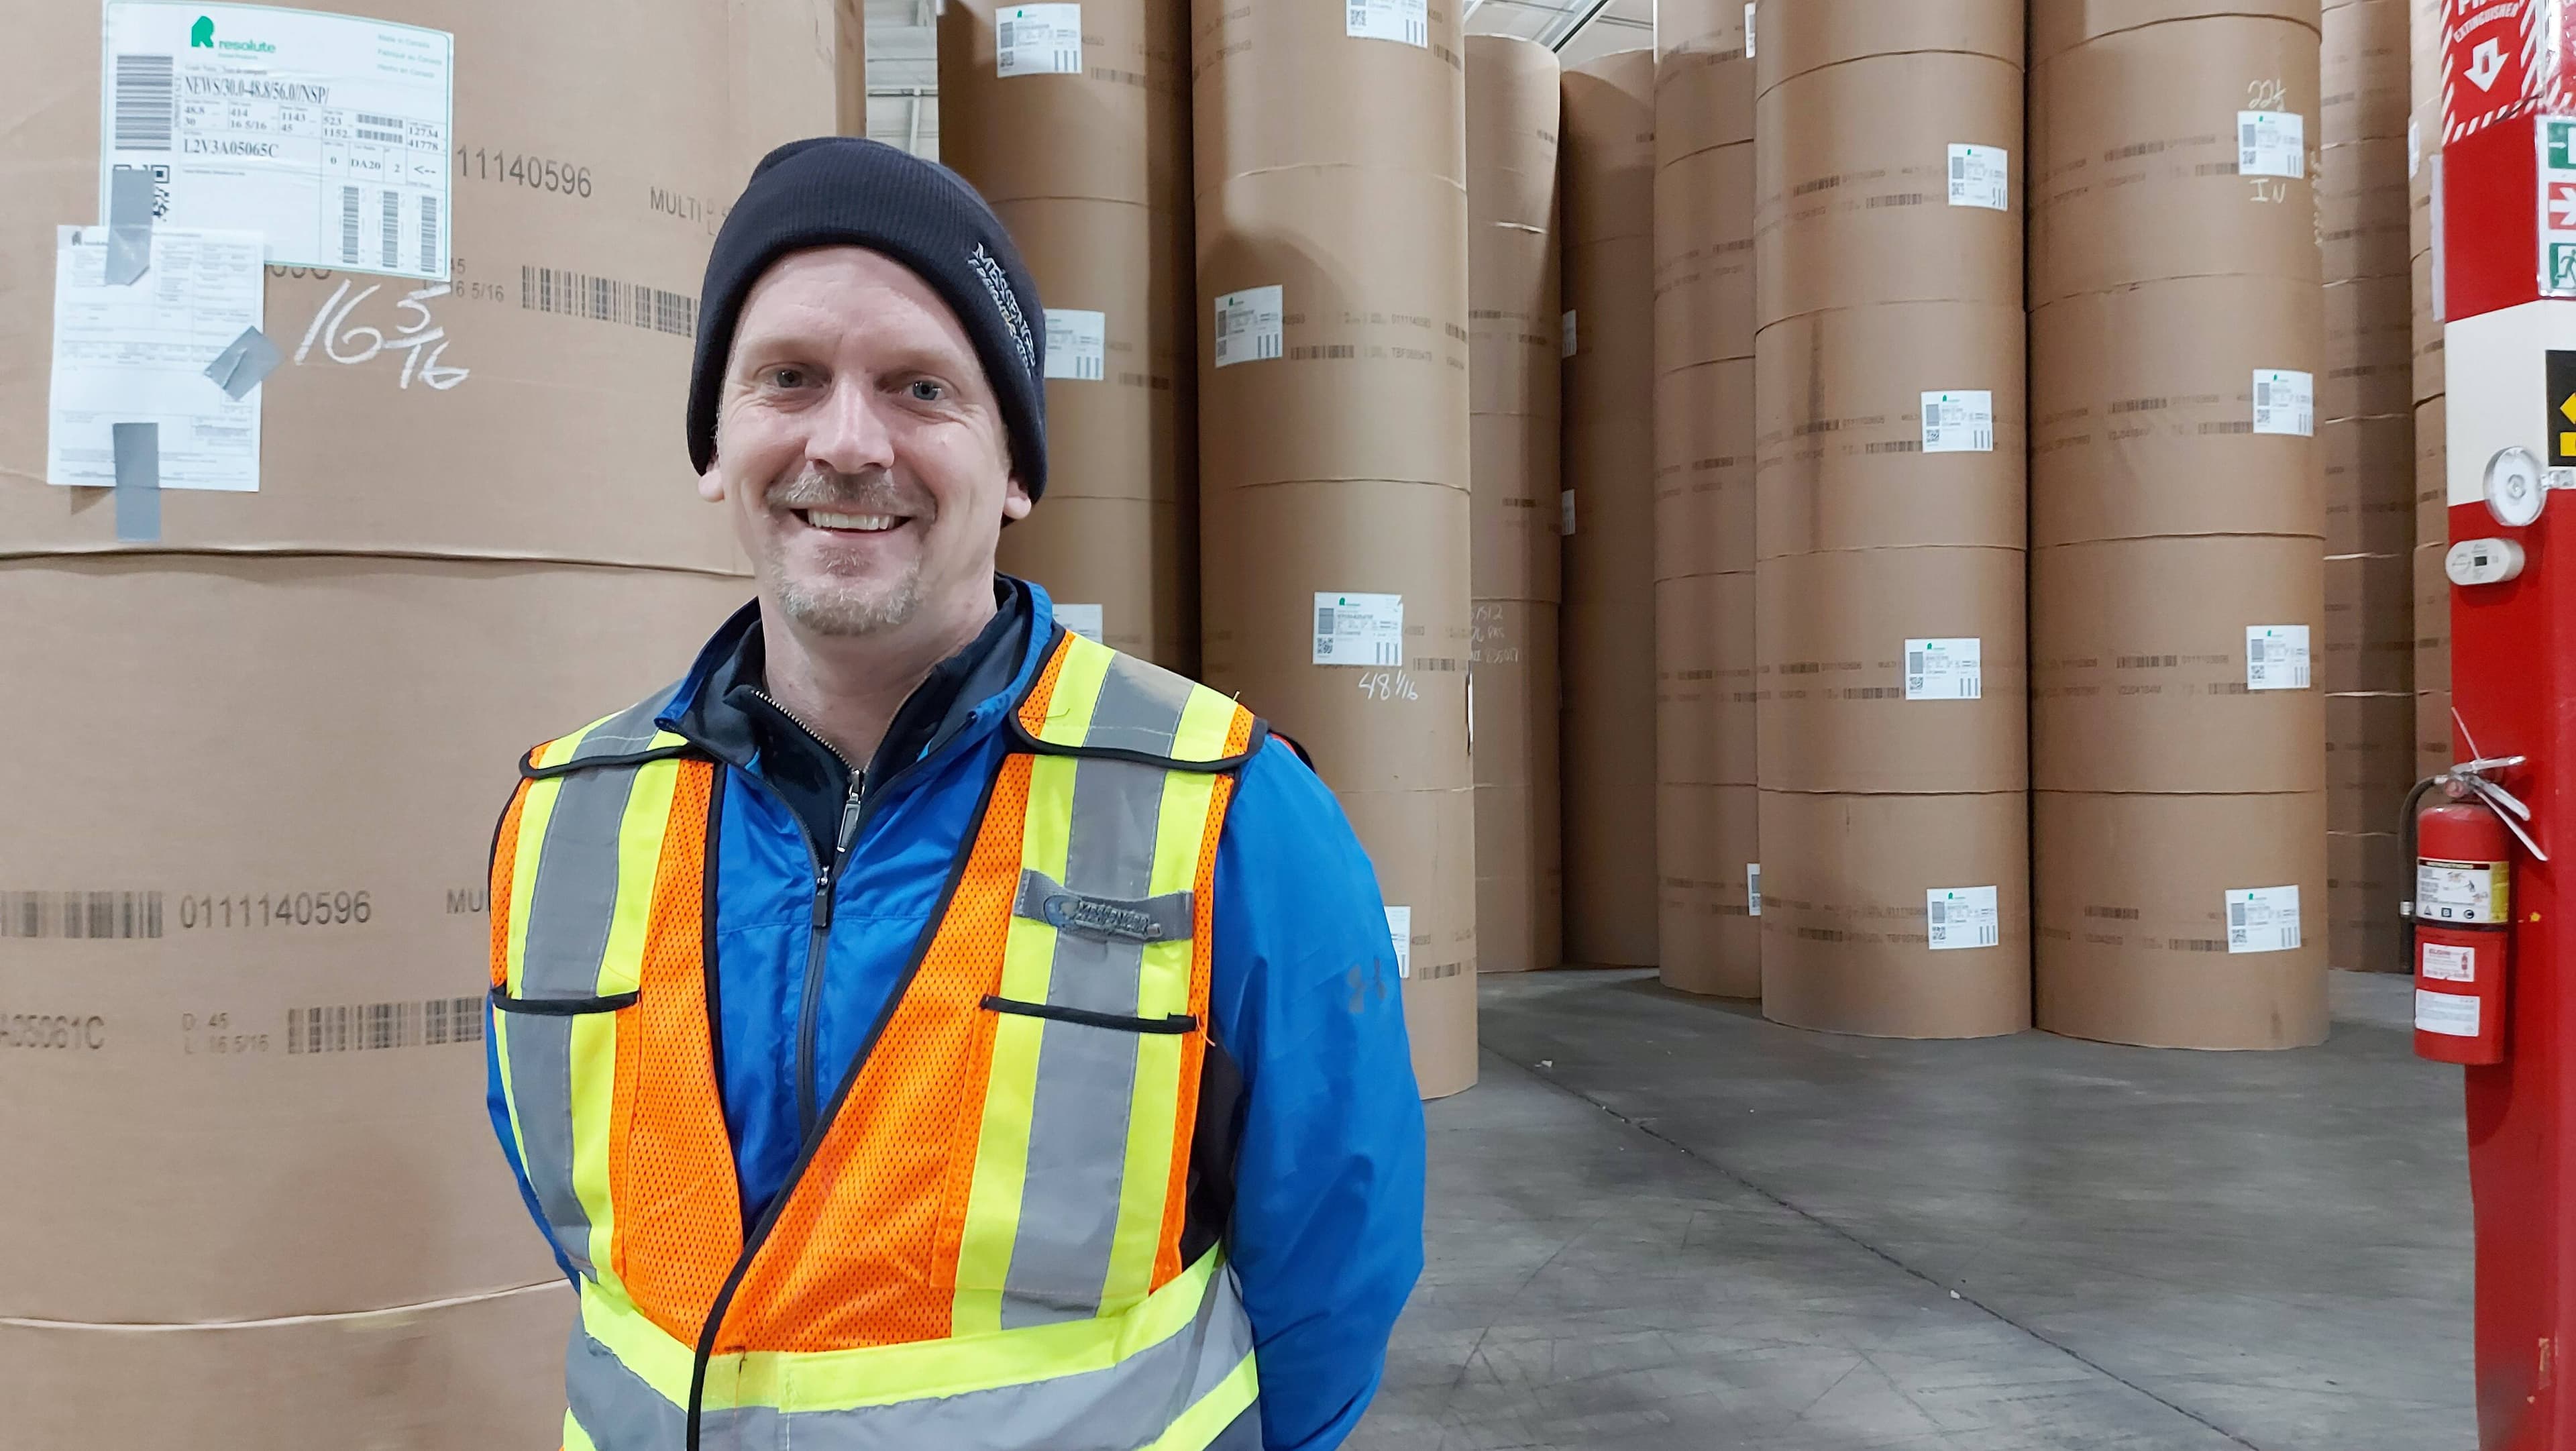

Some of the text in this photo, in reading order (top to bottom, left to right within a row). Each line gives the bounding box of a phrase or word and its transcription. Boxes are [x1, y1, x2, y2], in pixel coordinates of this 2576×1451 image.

[219, 40, 276, 54] resolute
[230, 107, 249, 117] 414
[282, 111, 307, 123] 1143
[230, 119, 242, 129] 16
[280, 123, 294, 133] 45
[183, 138, 280, 158] L2V3A05065C
[350, 158, 382, 170] DA20
[394, 163, 401, 173] 2
[456, 144, 702, 223] 11140596 MULTI
[471, 284, 504, 303] 5/16
[1358, 671, 1391, 701] 48
[180, 888, 491, 929] 0111140596 MU
